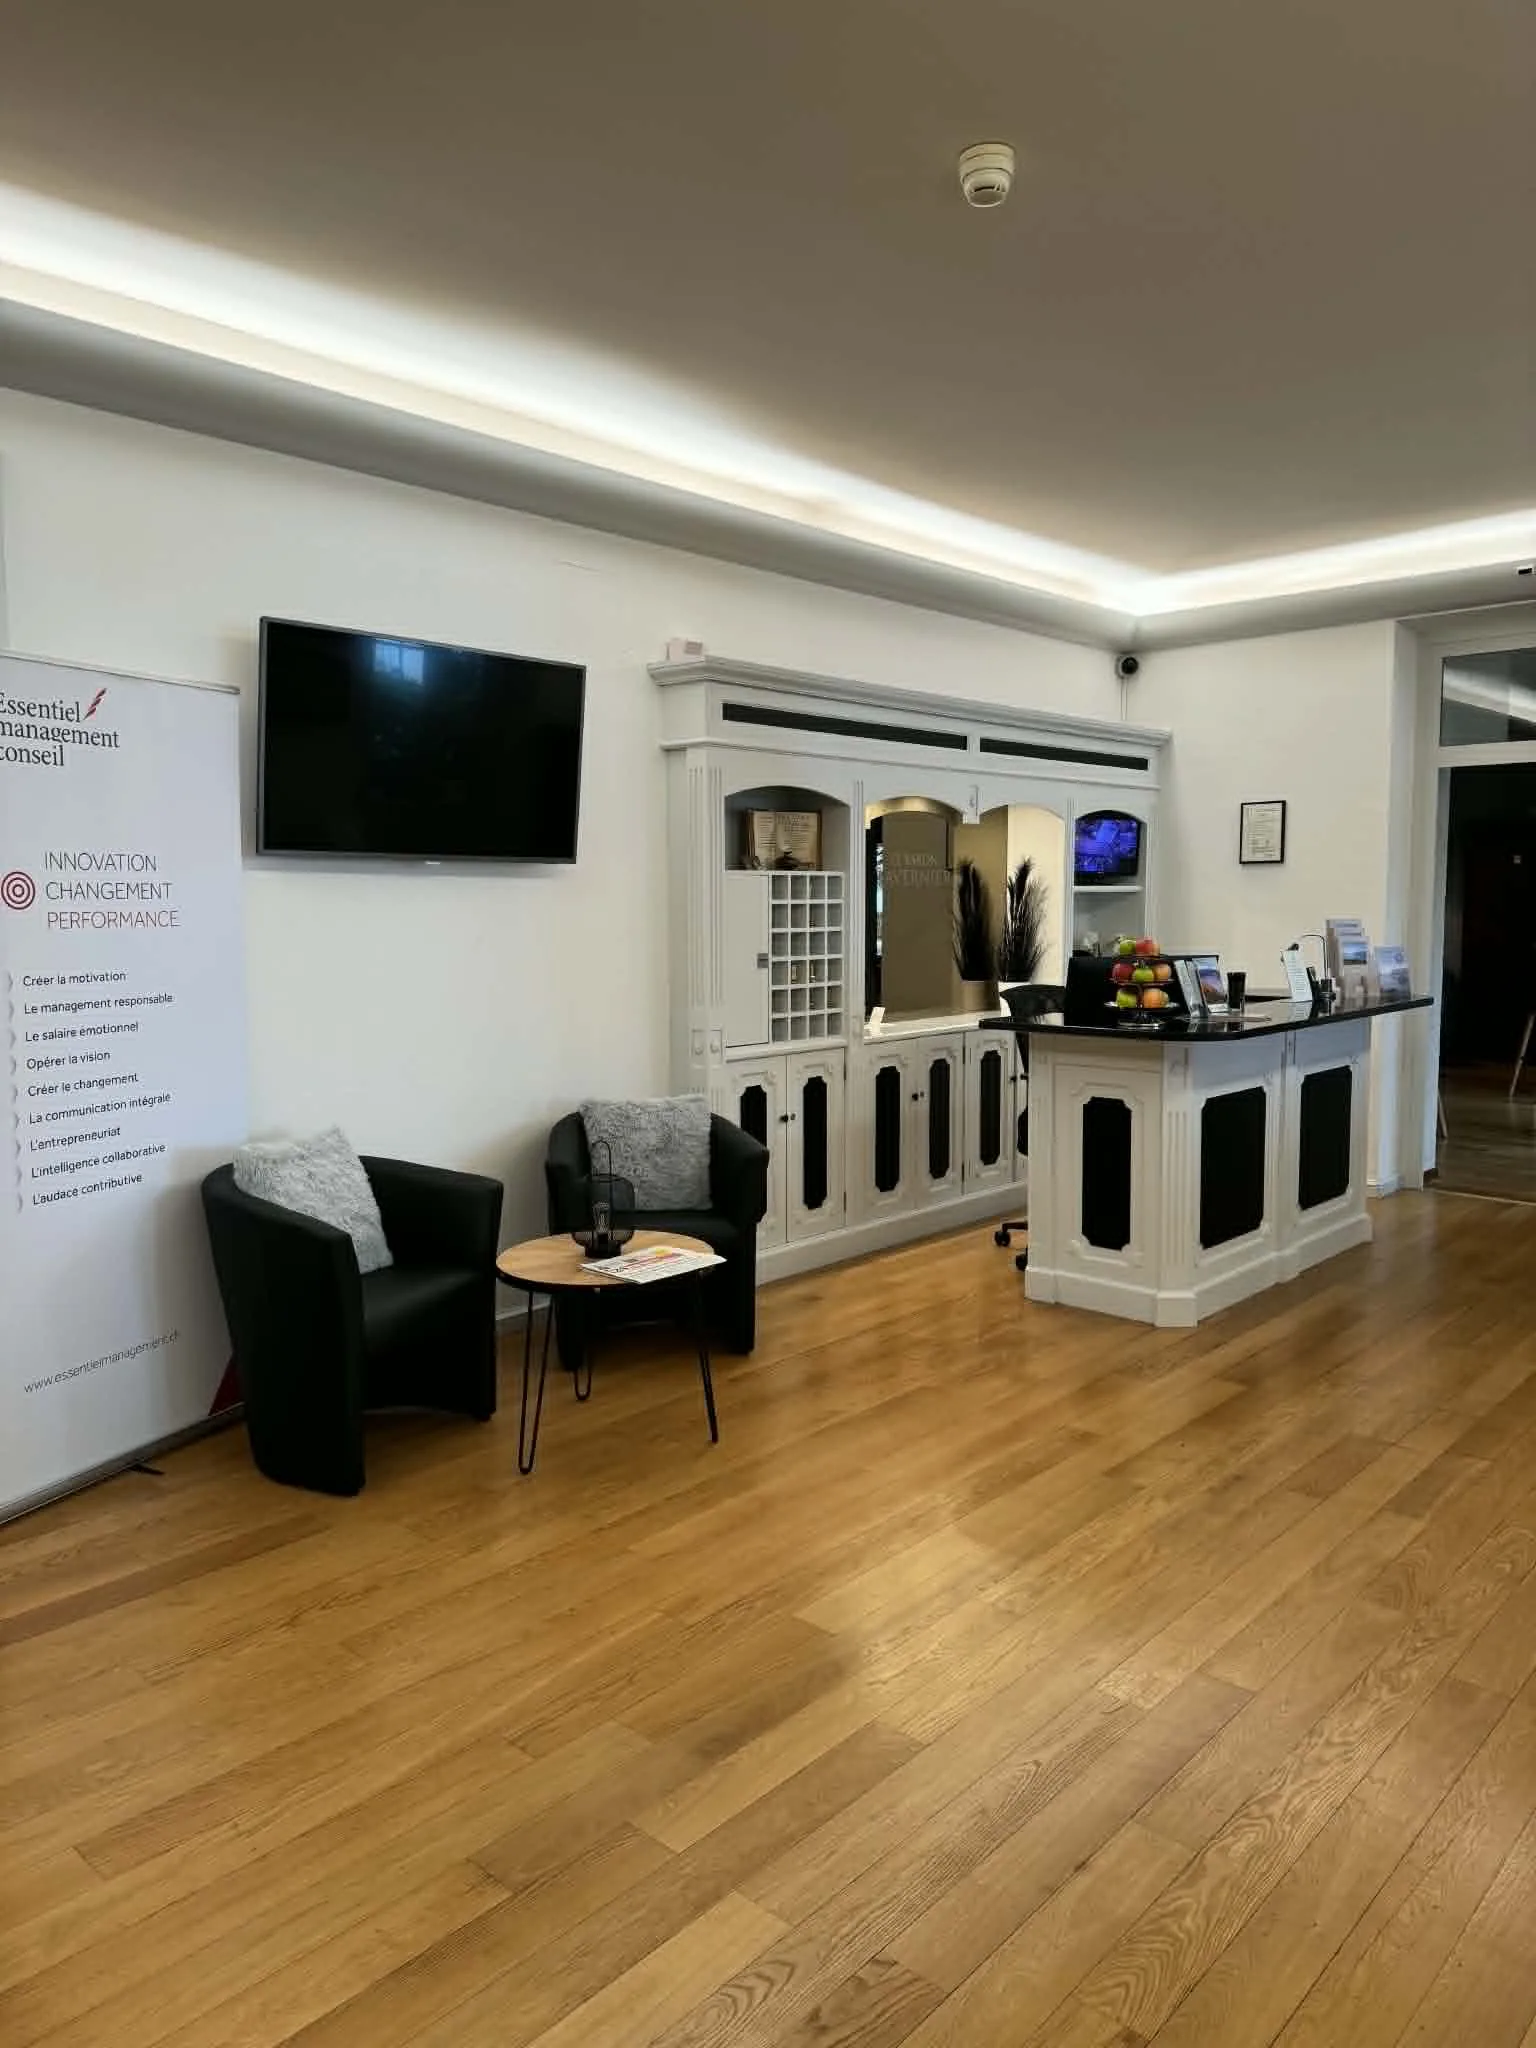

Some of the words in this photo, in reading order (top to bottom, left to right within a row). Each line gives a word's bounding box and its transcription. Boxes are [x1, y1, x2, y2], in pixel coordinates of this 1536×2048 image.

[0, 720, 120, 748] management
[45, 852, 157, 872] INNOVATION
[46, 882, 172, 900] CHANGEMENT
[48, 910, 181, 930] PERFORMANCE
[23, 974, 55, 986] Créer
[57, 974, 66, 985] la
[68, 971, 127, 984] motivation
[24, 1003, 38, 1015] Le
[40, 999, 112, 1014] management
[114, 993, 173, 1009] responsable
[25, 1031, 40, 1042] Le
[42, 1027, 77, 1041] salaire
[26, 1056, 66, 1071] Opérer
[68, 1055, 78, 1065] la
[80, 1050, 111, 1064] vision
[27, 1083, 59, 1097] Créer
[62, 1081, 71, 1093] le
[73, 1072, 139, 1089] changement
[29, 1111, 43, 1125] La
[45, 1099, 127, 1122] communication
[129, 1092, 171, 1108] intégrale
[102, 1144, 166, 1164] collaborative
[82, 1174, 142, 1194] contributive
